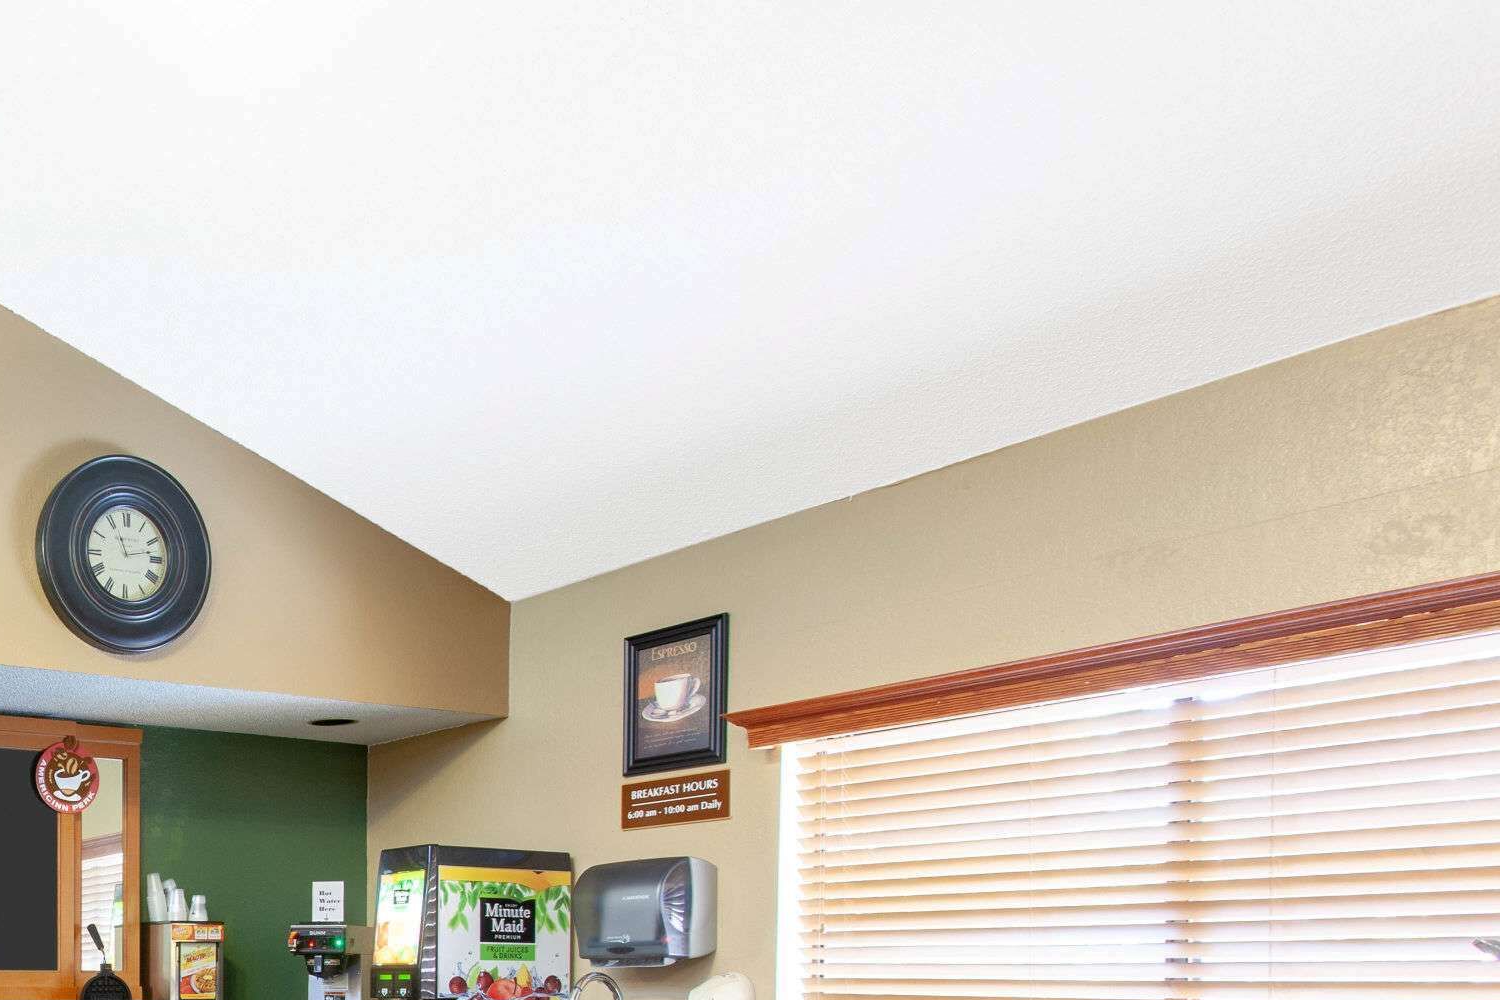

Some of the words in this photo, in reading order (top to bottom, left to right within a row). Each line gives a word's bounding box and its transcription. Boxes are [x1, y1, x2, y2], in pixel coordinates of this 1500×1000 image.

[651, 641, 698, 662] ESPRESSO
[630, 783, 681, 801] BREAKFAST
[682, 778, 719, 793] HOURS
[627, 809, 644, 820] 6:00
[645, 808, 657, 817] am
[663, 804, 686, 815] 10:00
[686, 803, 699, 812] am
[700, 799, 723, 811] Daily
[484, 902, 532, 919] Minute
[490, 918, 525, 933] Maid
[485, 945, 505, 954] FRUIT
[506, 945, 529, 954] JUICES
